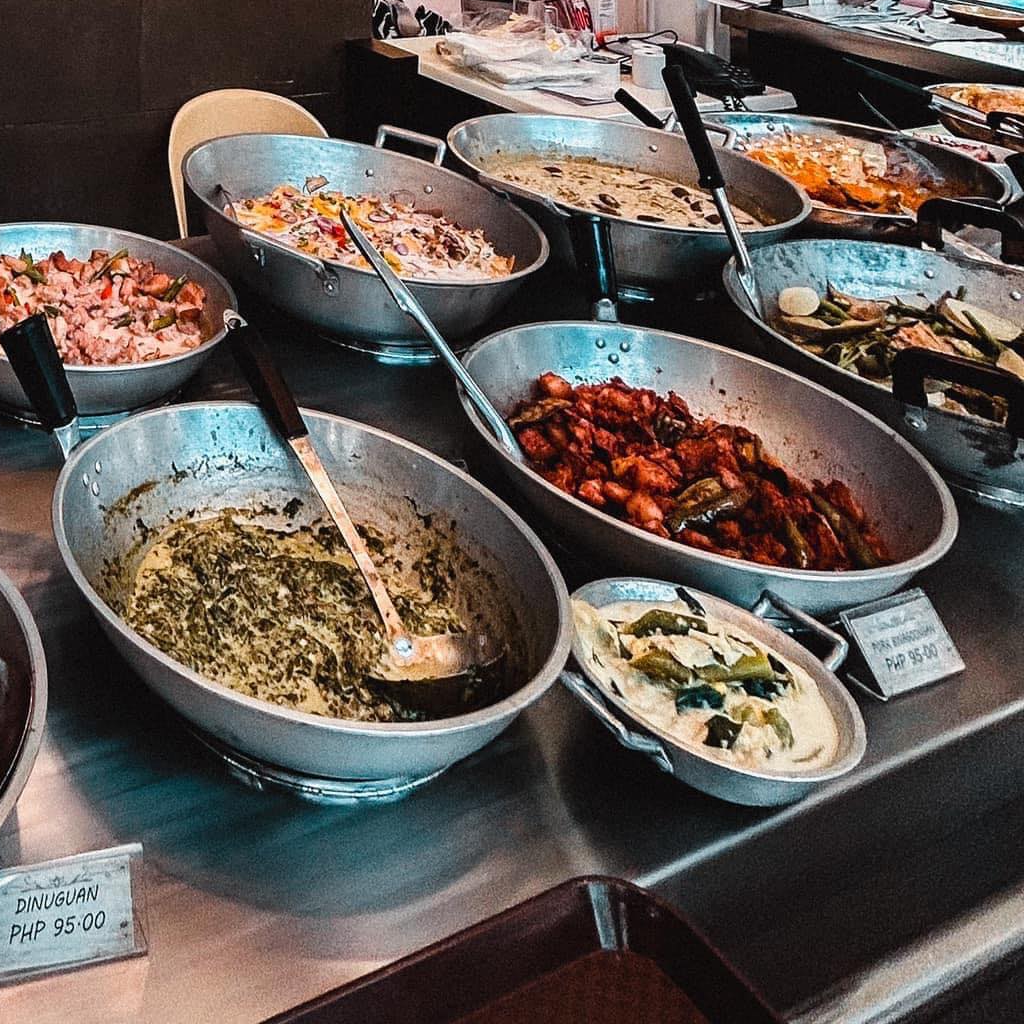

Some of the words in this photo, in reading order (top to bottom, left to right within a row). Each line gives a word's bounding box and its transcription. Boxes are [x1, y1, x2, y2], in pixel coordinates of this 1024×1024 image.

[885, 652, 907, 673] PHP
[15, 883, 99, 915] DINUGUAN
[9, 919, 46, 945] PHP
